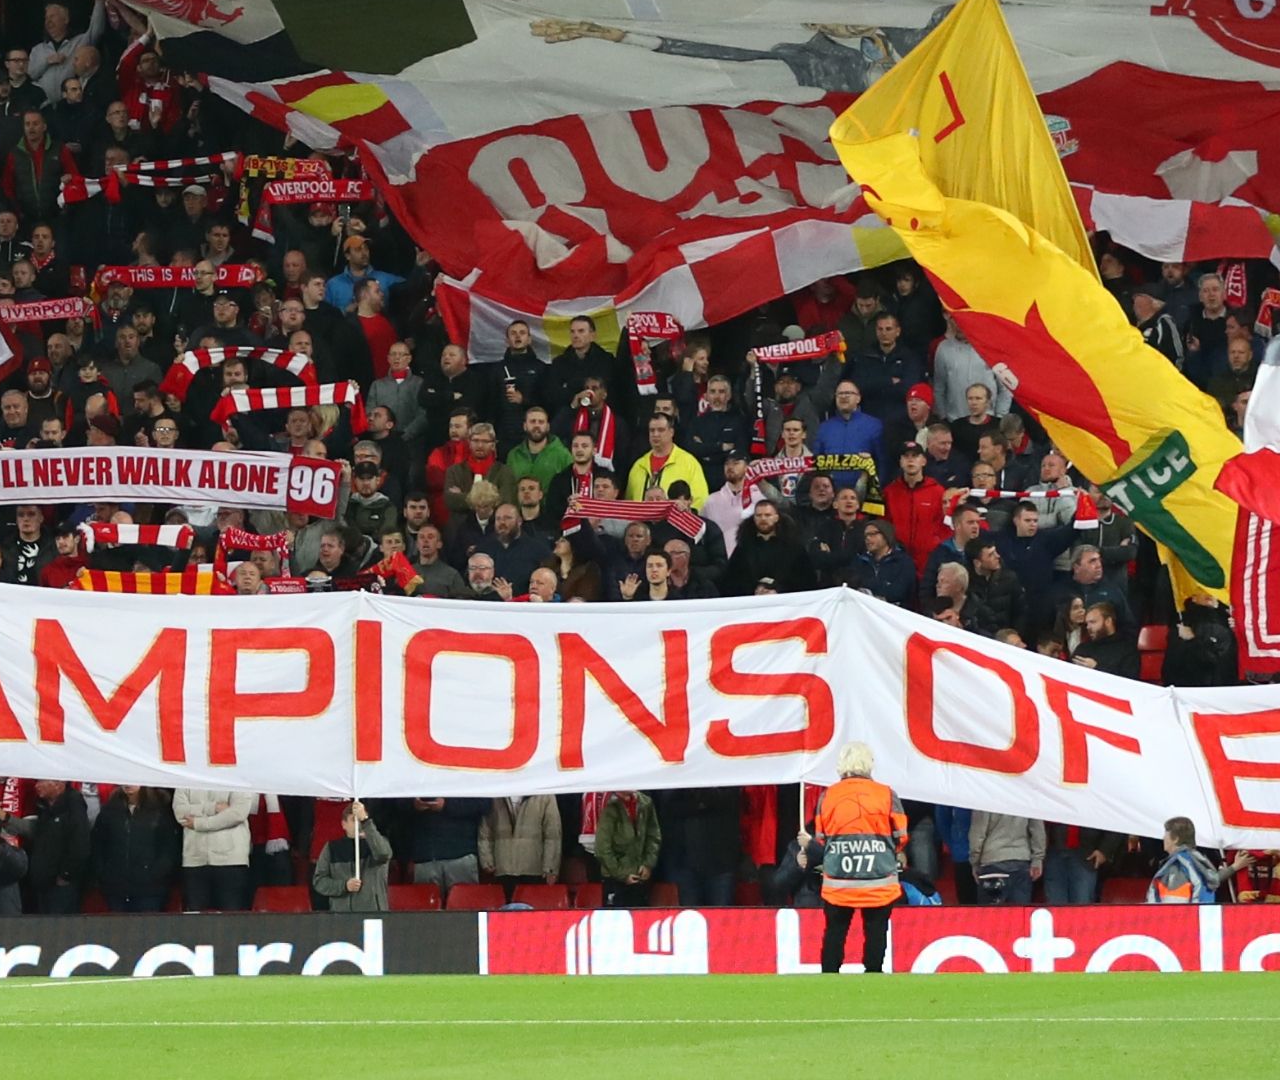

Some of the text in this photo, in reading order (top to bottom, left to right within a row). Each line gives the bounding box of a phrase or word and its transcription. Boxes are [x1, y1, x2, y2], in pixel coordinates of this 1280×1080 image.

[269, 180, 363, 196] LIVERPOOL FC
[129, 268, 173, 282] THIS IS
[0, 301, 84, 321] LIVERPOOL
[753, 336, 820, 358] LIVERPOOL
[745, 454, 876, 481] LIVERPOOL SALZBURG
[32, 455, 335, 505] NEVER WALK ALONE 96
[1106, 448, 1189, 513] TICE
[904, 630, 1143, 785] OF
[827, 839, 886, 855] STEWARD
[841, 855, 875, 873] 077
